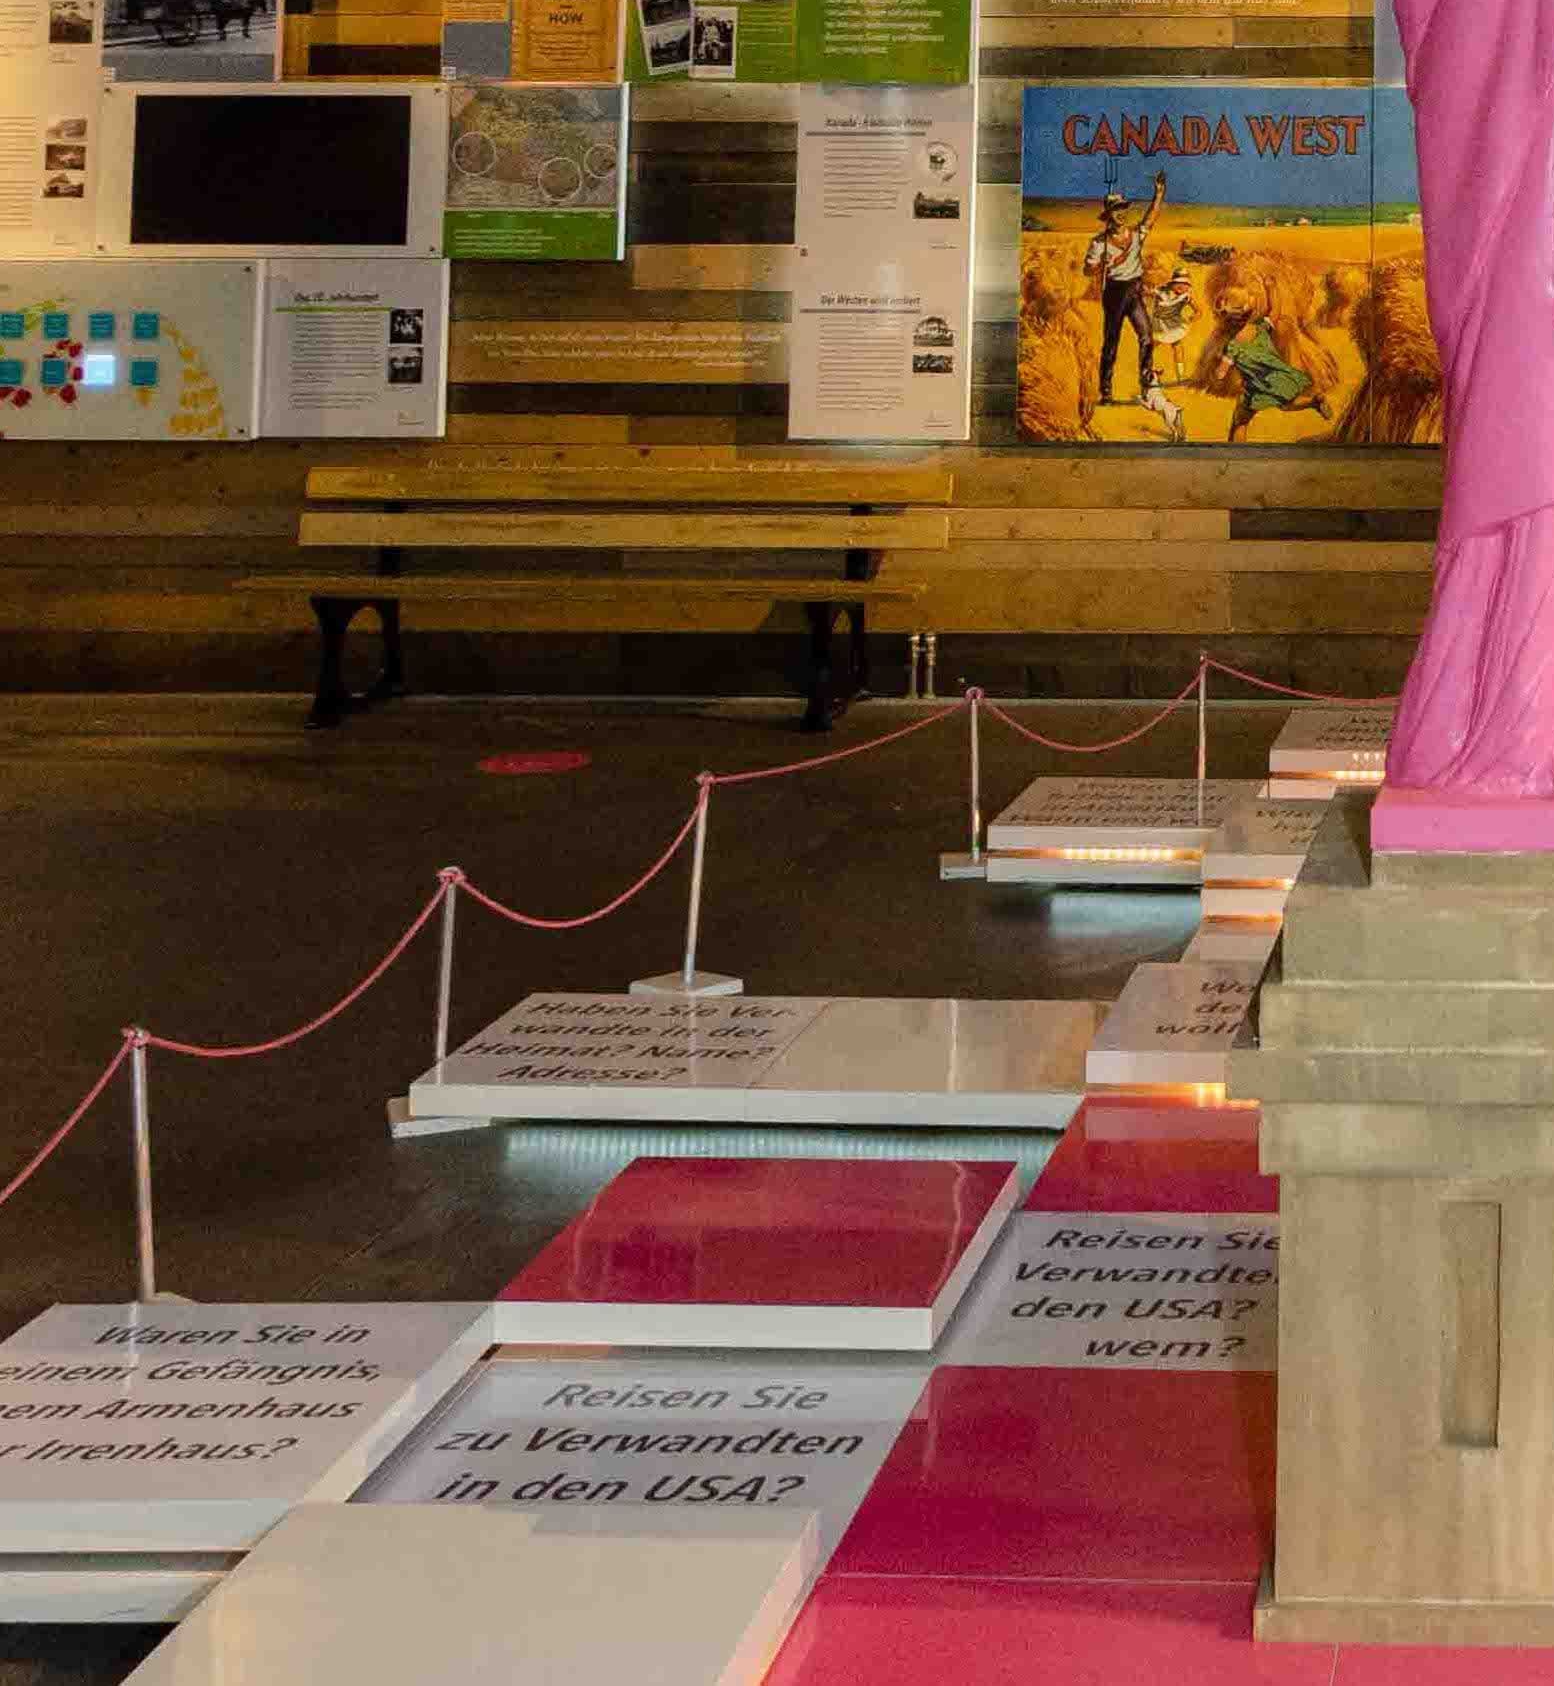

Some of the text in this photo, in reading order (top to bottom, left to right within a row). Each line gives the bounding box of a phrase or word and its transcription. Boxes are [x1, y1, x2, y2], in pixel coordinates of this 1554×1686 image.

[549, 12, 584, 24] HOW
[1062, 114, 1367, 159] CANADA WEST
[528, 1001, 654, 1017] Haben
[509, 1022, 653, 1040] wandte
[706, 1022, 776, 1040] der
[460, 1042, 780, 1061] Heimat? Name?
[496, 1063, 690, 1082] Adresse?
[1044, 1227, 1204, 1253] Reisen
[1011, 1260, 1279, 1286] Verwandte
[1009, 1296, 1261, 1321] den USA?
[94, 1324, 372, 1346] Waren Sie in
[1085, 1335, 1248, 1361] wem?
[146, 1359, 383, 1386] Gefängnis,
[80, 1397, 366, 1420] Armenhaus
[542, 1383, 830, 1413] Reisen Sie
[23, 1436, 300, 1462] Irrenhaus?
[434, 1426, 866, 1457] zu Verwandten
[433, 1472, 809, 1505] in den USA?
